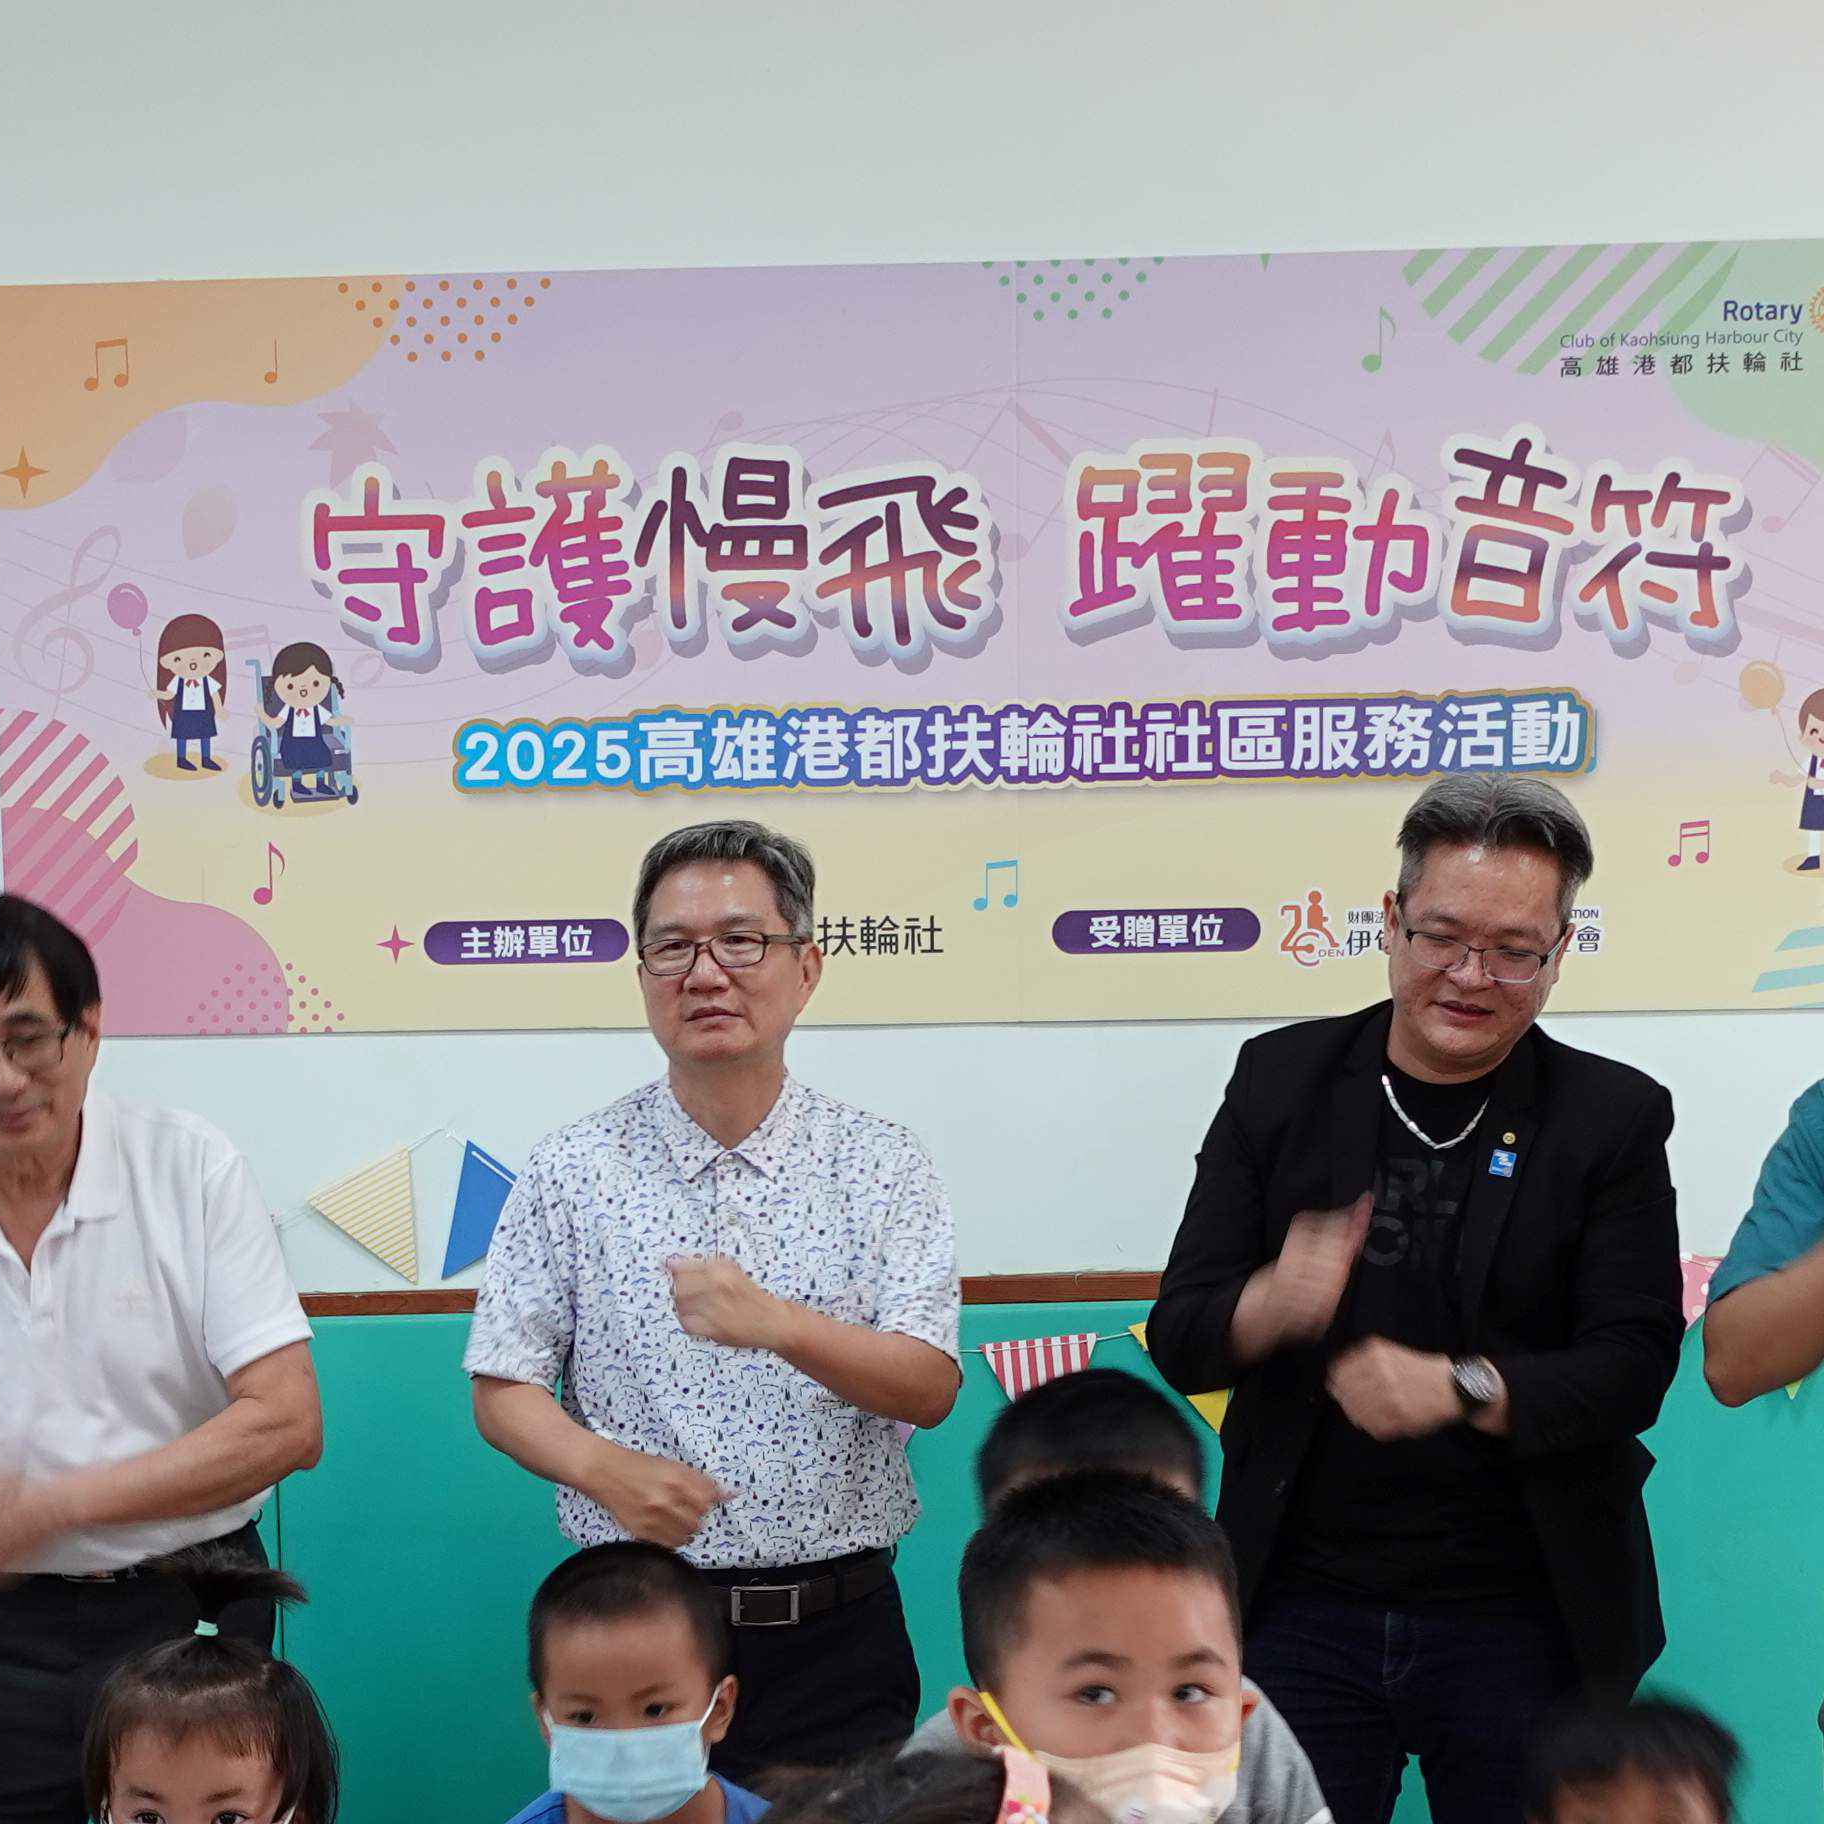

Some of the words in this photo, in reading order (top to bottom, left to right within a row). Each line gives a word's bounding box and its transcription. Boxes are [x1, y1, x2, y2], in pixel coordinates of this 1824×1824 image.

[1723, 300, 1803, 325] Rotary
[1560, 334, 1595, 349] Club
[1599, 332, 1616, 348] of
[1620, 330, 1700, 351] Kaohsiung
[1705, 329, 1769, 347] Harbour
[1773, 328, 1804, 348] City
[1560, 353, 1804, 378] 高雄港都扶輪社
[314, 457, 982, 651] 守護慢飛
[1068, 437, 1732, 632] 躍動音符
[465, 700, 1579, 783] 2025高雄港都扶輪社社區服務活動
[460, 925, 593, 959] 主辦單位
[1088, 914, 1224, 949] 受贈單位
